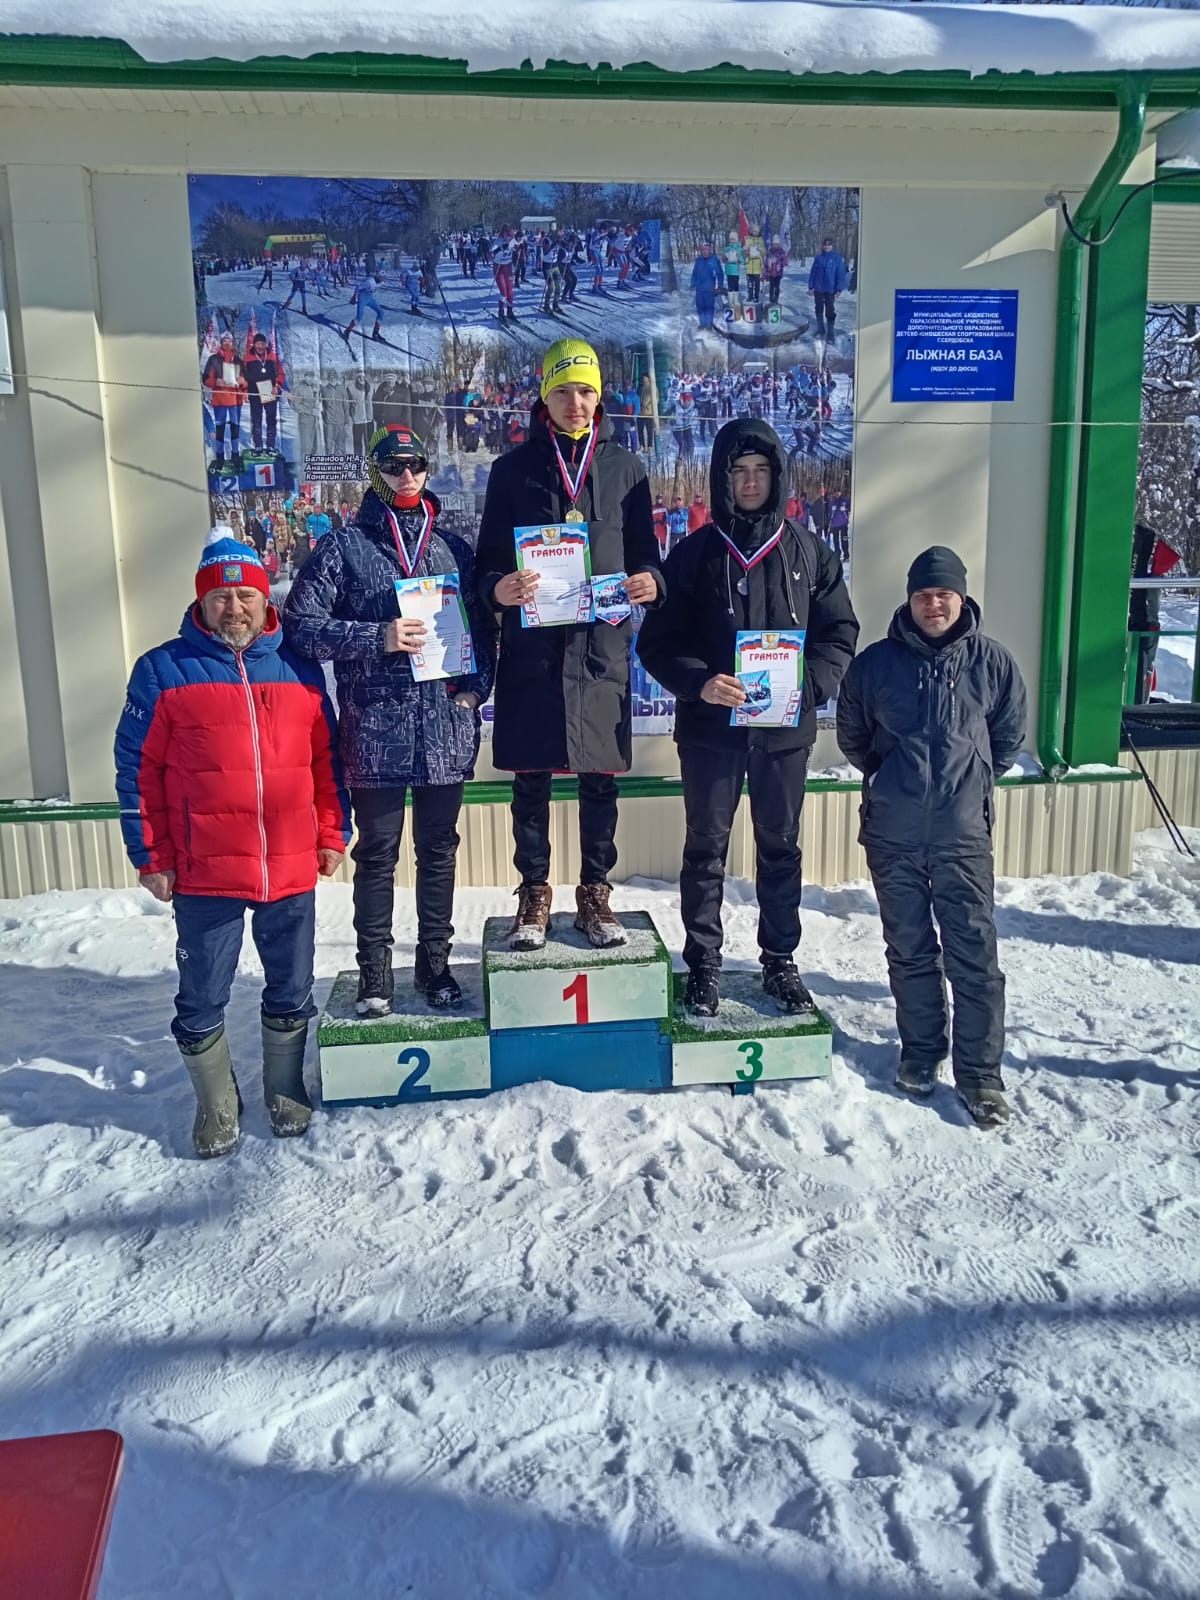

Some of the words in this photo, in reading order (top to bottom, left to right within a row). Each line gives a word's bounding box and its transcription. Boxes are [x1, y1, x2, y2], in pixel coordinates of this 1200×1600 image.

[725, 309, 734, 323] 2
[746, 307, 755, 321] 1
[769, 309, 779, 324] 3
[906, 349, 966, 361] ЛЫЖНАЯ
[969, 349, 1004, 361] БАЗА
[259, 465, 272, 485] 1
[305, 463, 341, 471] Анашкин
[220, 476, 238, 493] 2
[531, 547, 575, 559] ГРАМОТА
[749, 652, 790, 662] ГРАМОТА
[562, 973, 590, 1026] 1
[735, 1041, 764, 1082] 3
[397, 1047, 432, 1097] 2
